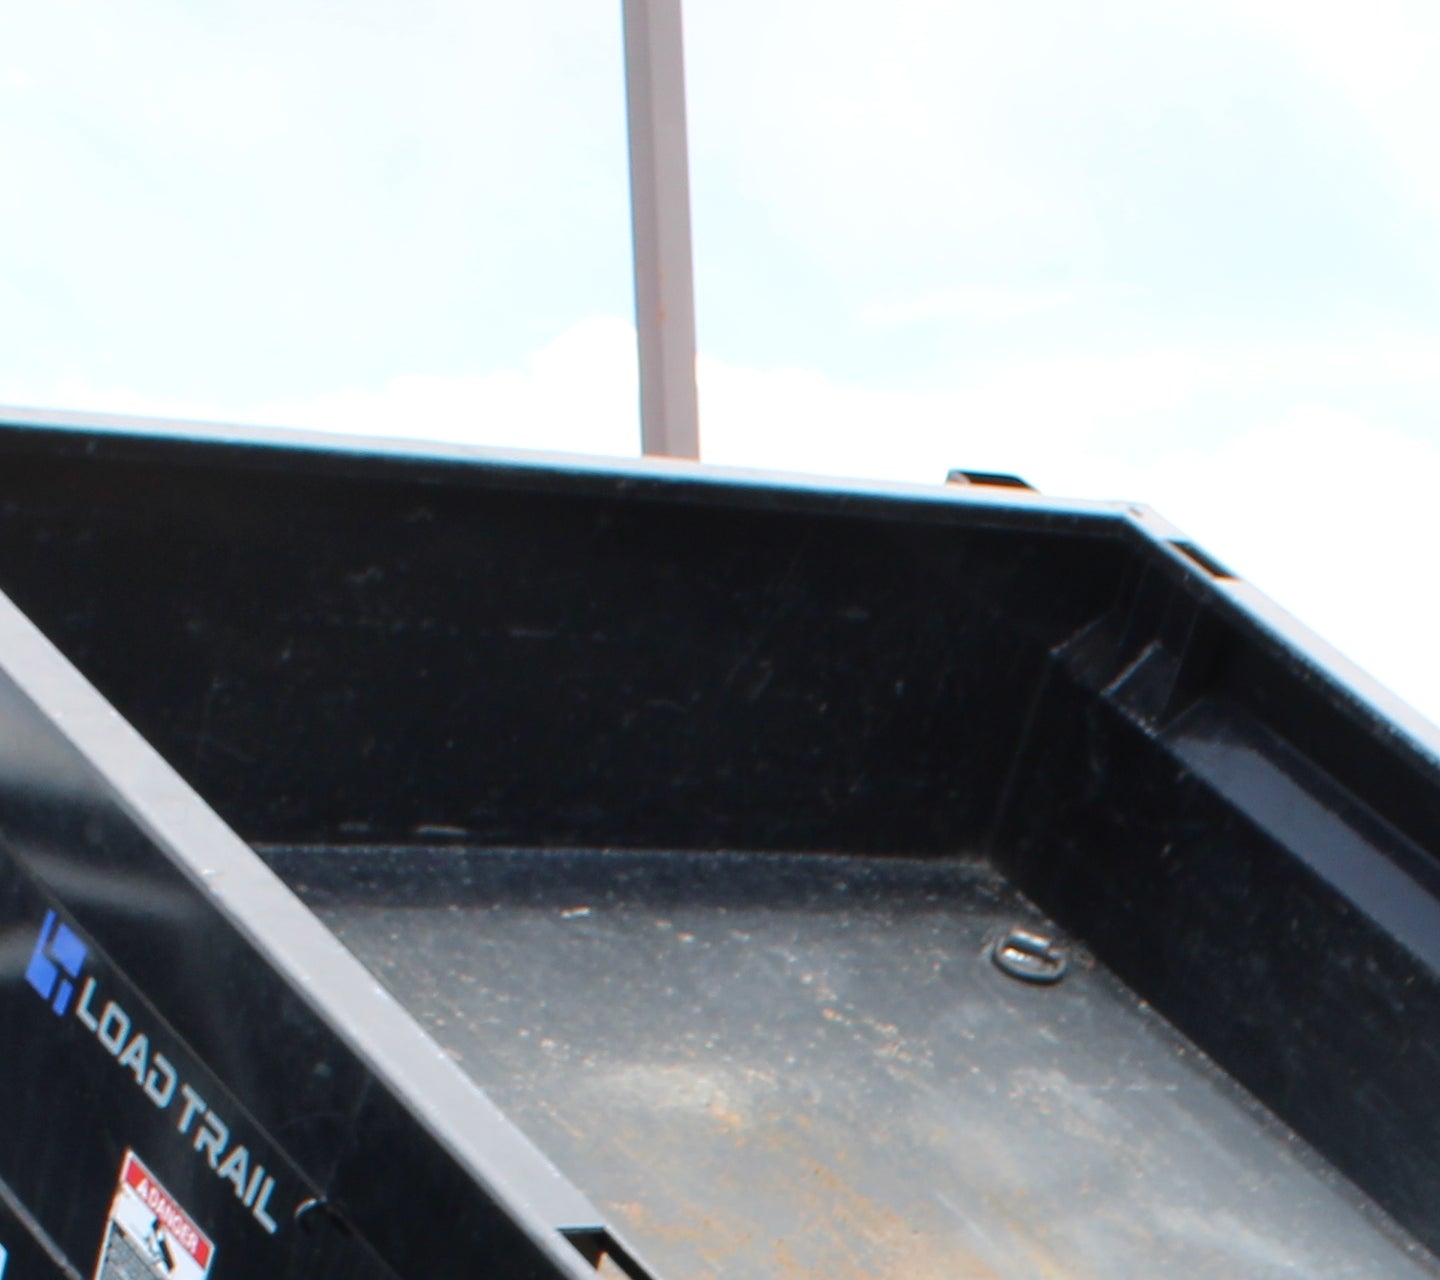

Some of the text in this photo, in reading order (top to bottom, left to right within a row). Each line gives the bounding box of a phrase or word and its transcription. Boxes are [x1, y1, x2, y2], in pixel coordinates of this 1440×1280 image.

[75, 976, 179, 1109] LOAD
[181, 1083, 278, 1235] TRAIL
[146, 1188, 200, 1255] DANGER
